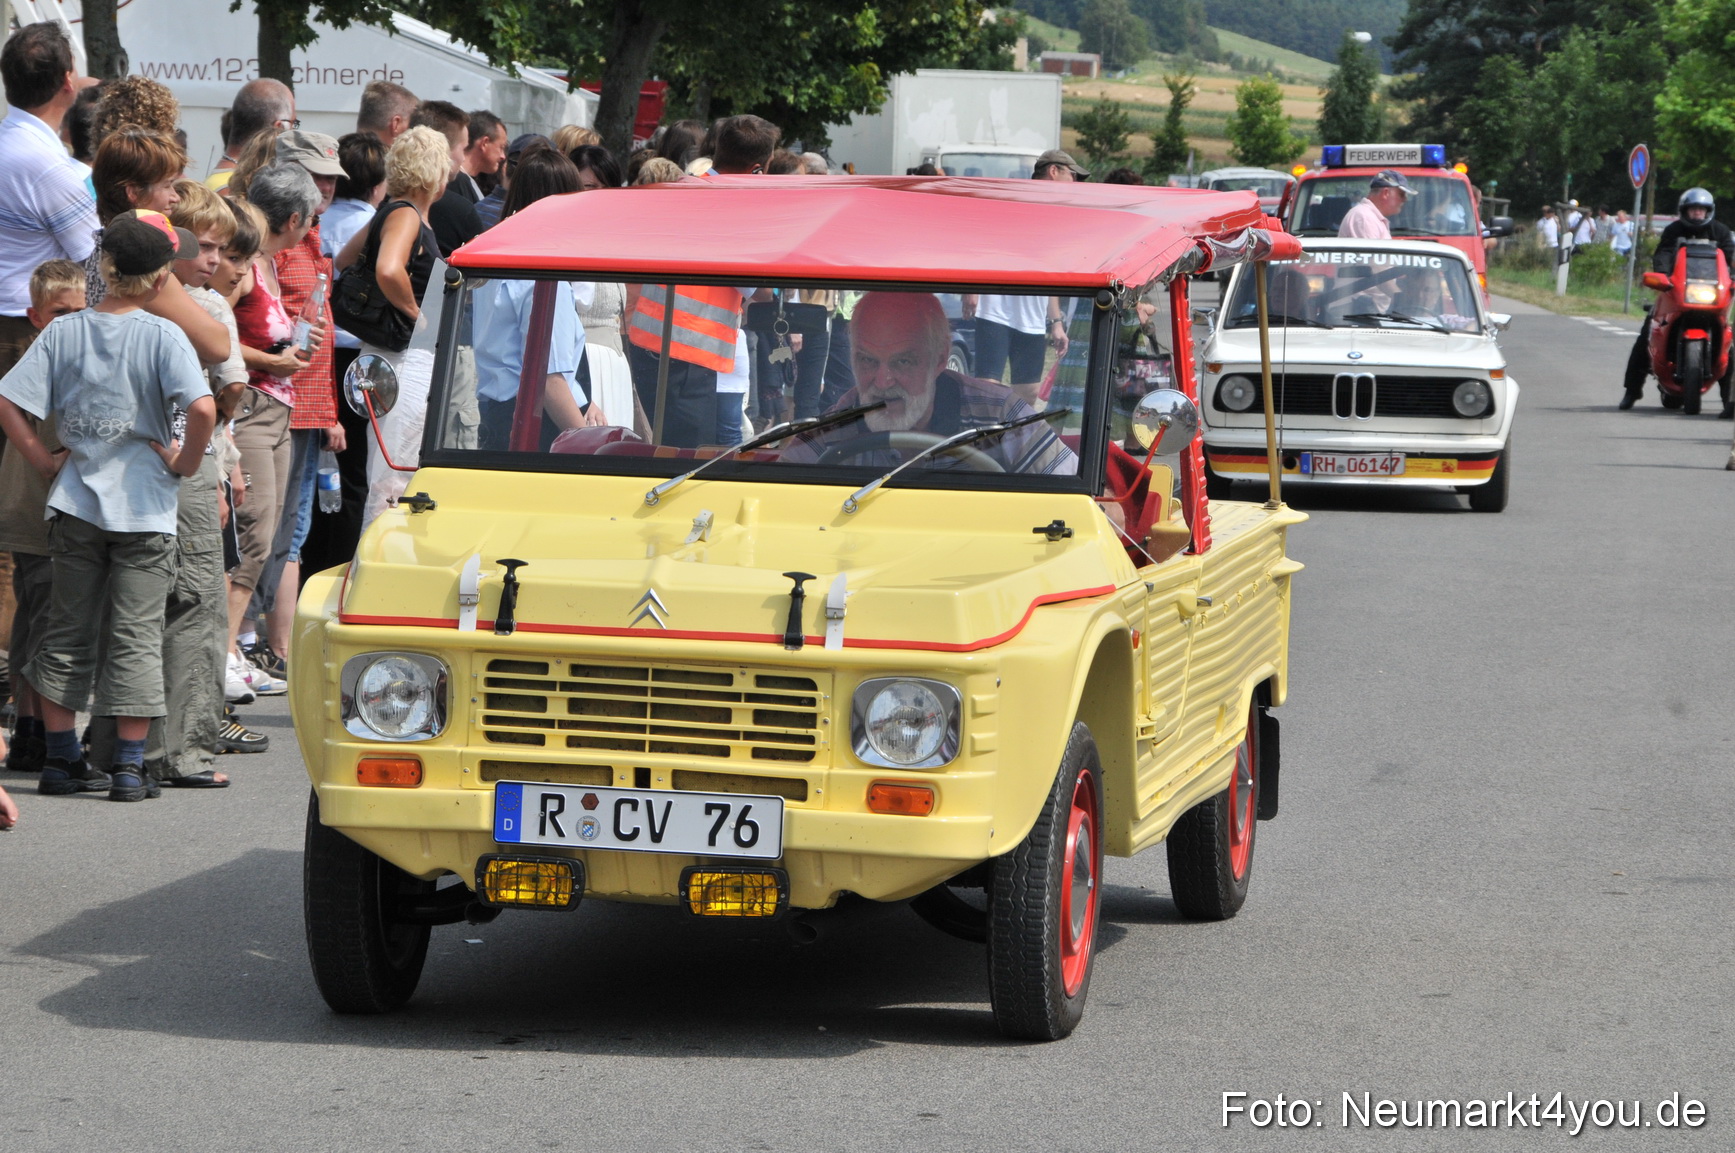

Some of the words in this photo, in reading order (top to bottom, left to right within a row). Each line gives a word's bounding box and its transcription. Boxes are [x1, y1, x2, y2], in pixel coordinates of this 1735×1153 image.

[140, 57, 404, 86] www.123chnerde
[1349, 150, 1418, 161] FEUERWEHR
[1270, 252, 1442, 269] NER-TUNING
[1313, 456, 1336, 472] RH
[1347, 457, 1401, 473] 06147
[503, 818, 513, 831] D
[539, 793, 566, 838] R
[613, 798, 673, 843] CV
[704, 802, 760, 849] 76
